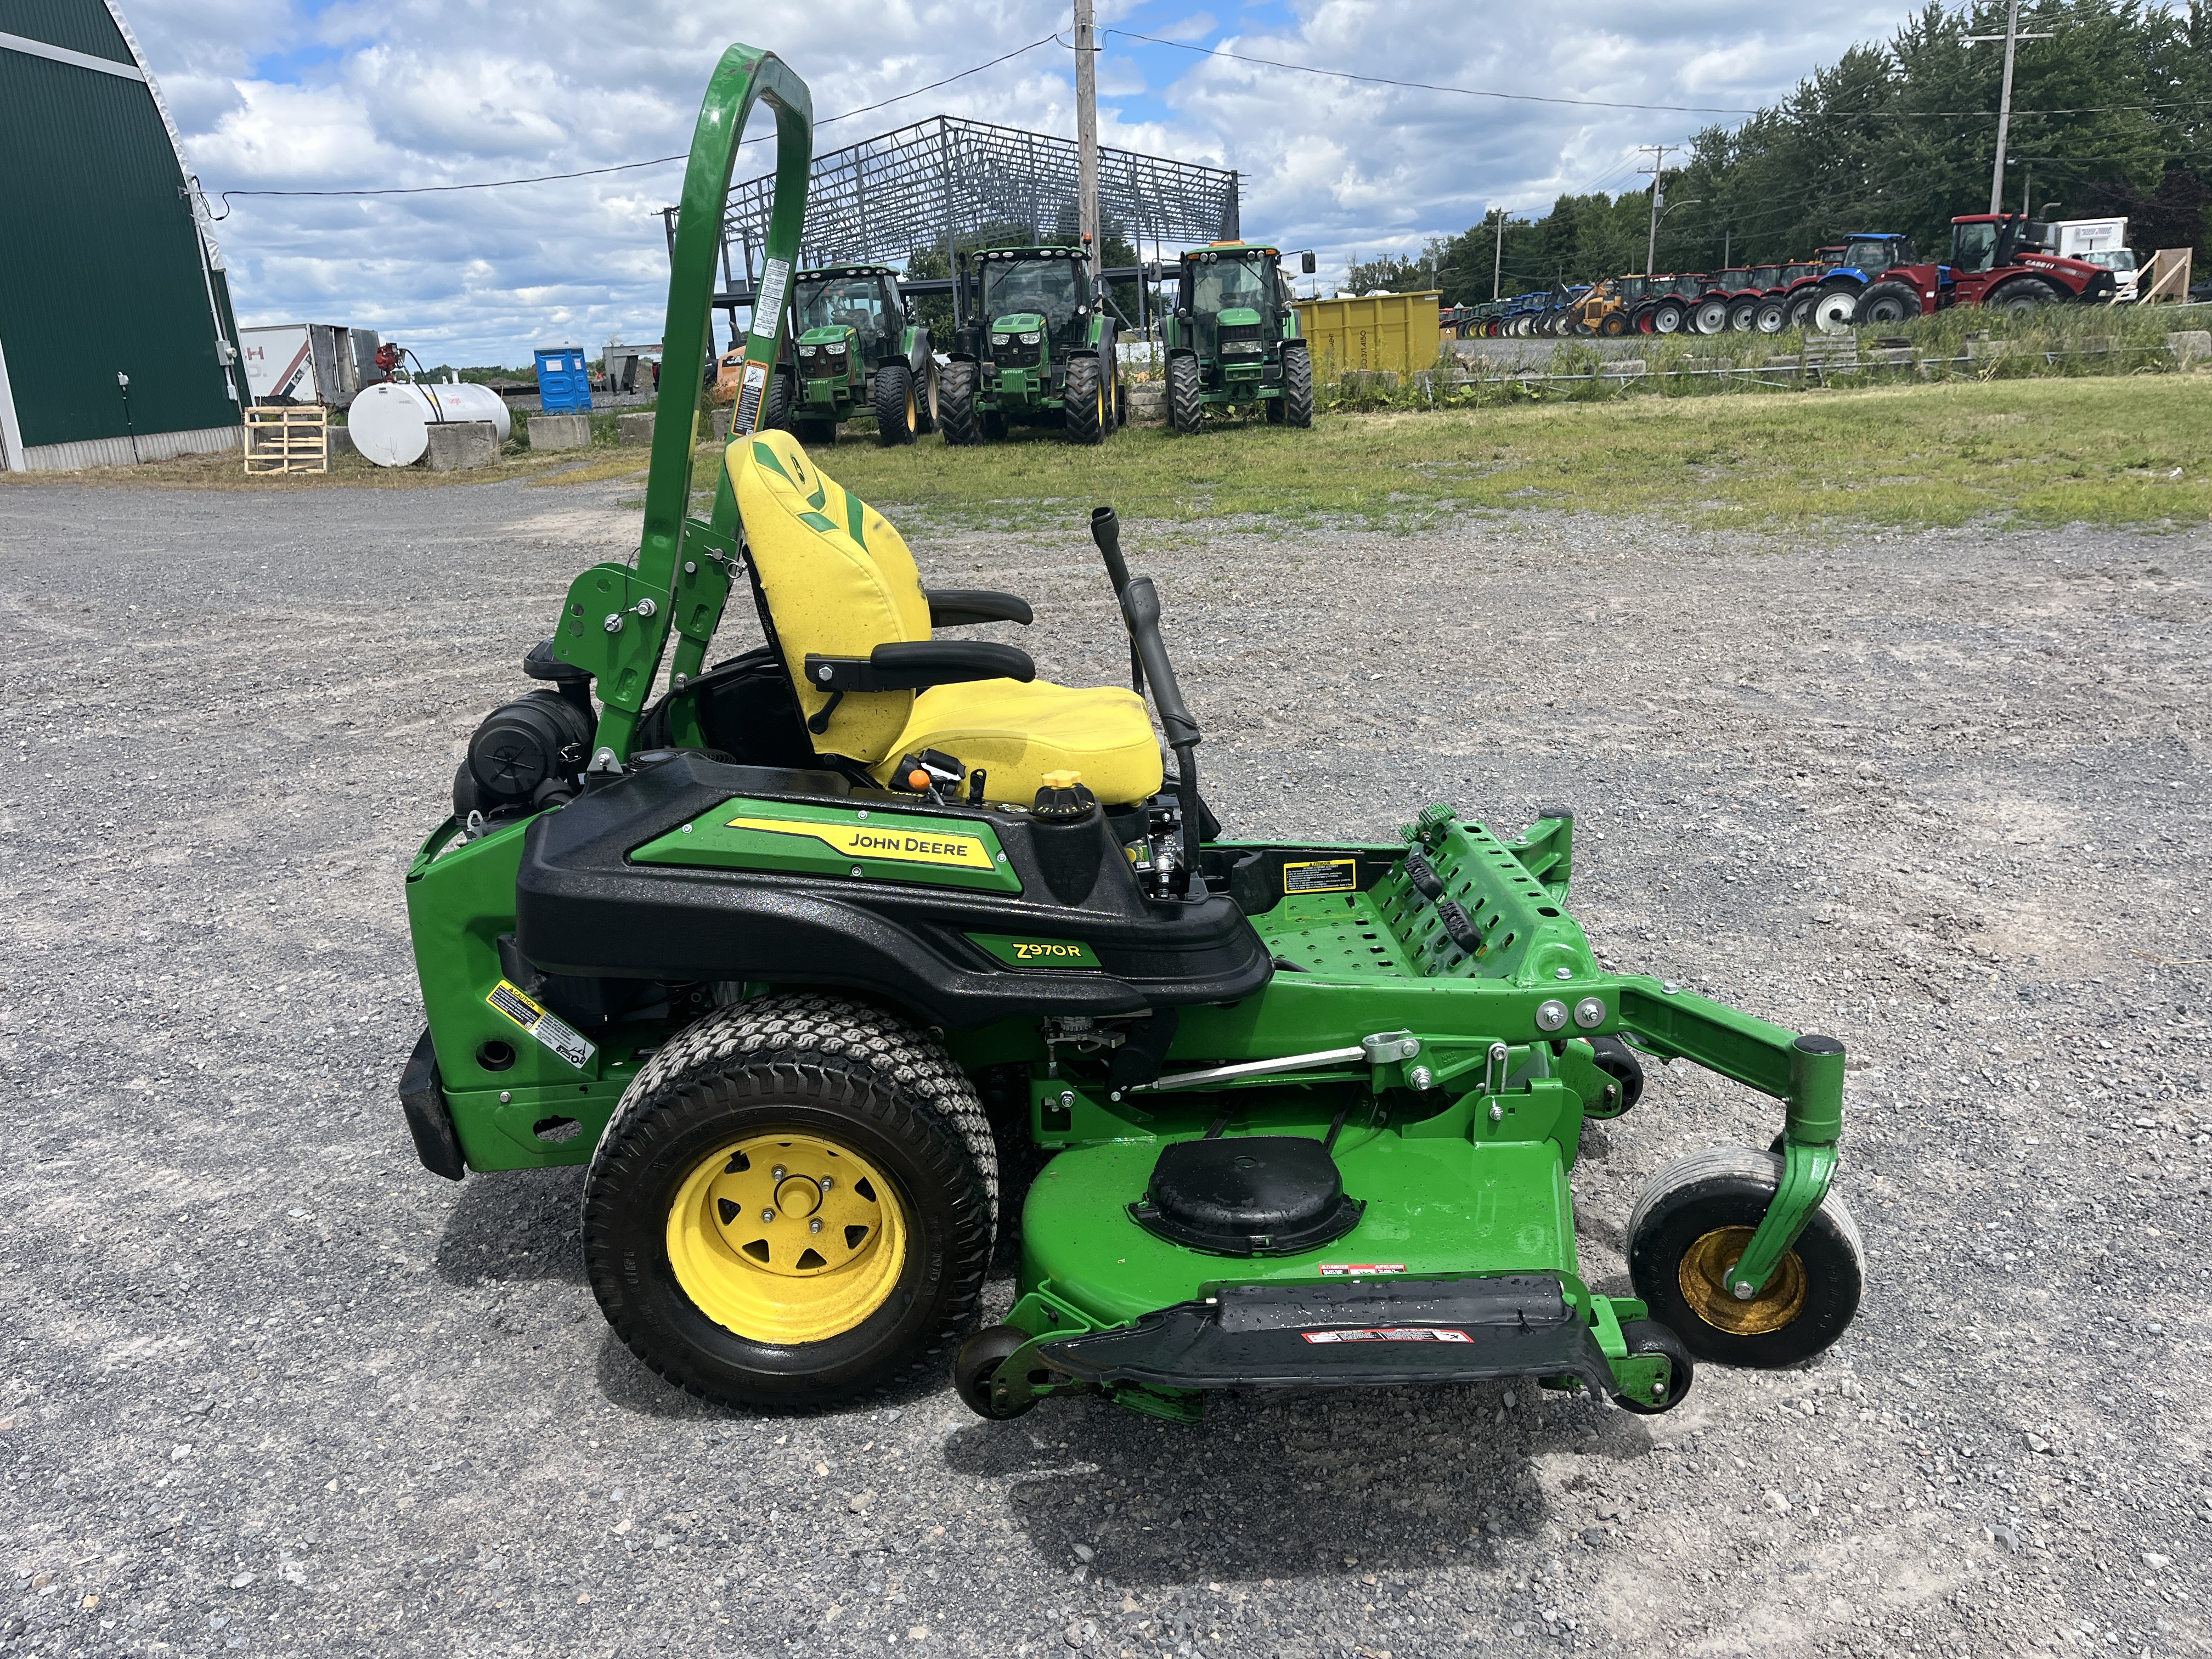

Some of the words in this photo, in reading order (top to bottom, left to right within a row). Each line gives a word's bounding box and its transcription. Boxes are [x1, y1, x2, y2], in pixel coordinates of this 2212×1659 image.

[849, 833, 900, 850] JOHN
[905, 838, 968, 856] DEERE
[1013, 944, 1082, 958] Z970R
[514, 990, 535, 1008] CAUTION
